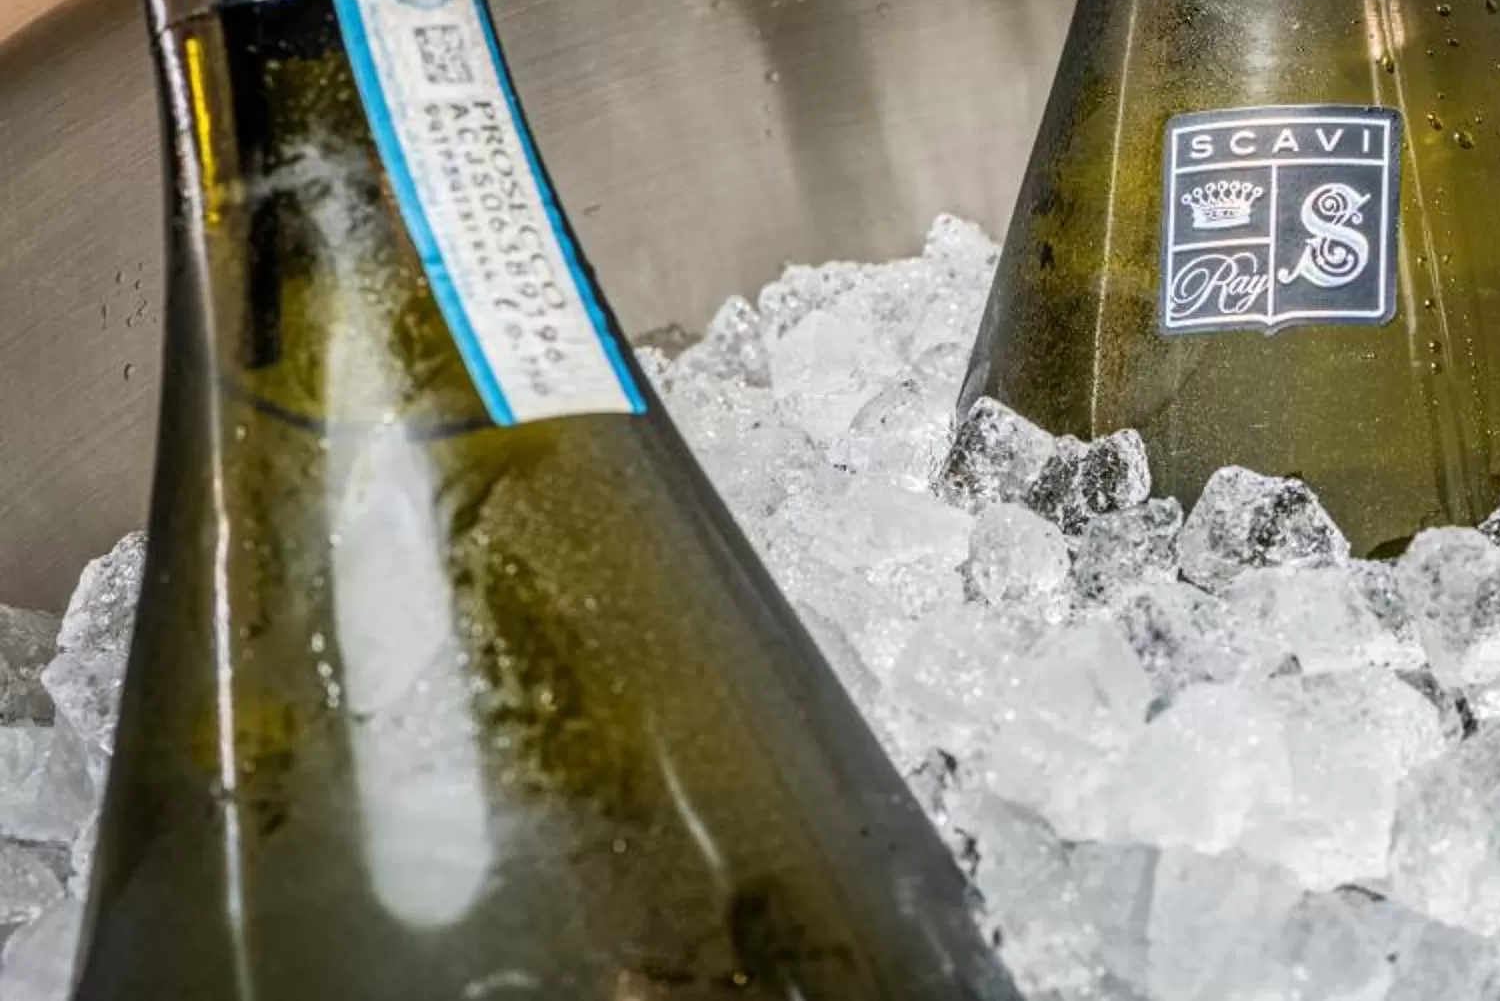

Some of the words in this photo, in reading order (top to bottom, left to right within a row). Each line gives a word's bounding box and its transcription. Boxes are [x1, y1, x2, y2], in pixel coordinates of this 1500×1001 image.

[1189, 128, 1371, 159] SCAVI
[472, 101, 567, 310] PROSECCO
[1168, 251, 1270, 318] Ray
